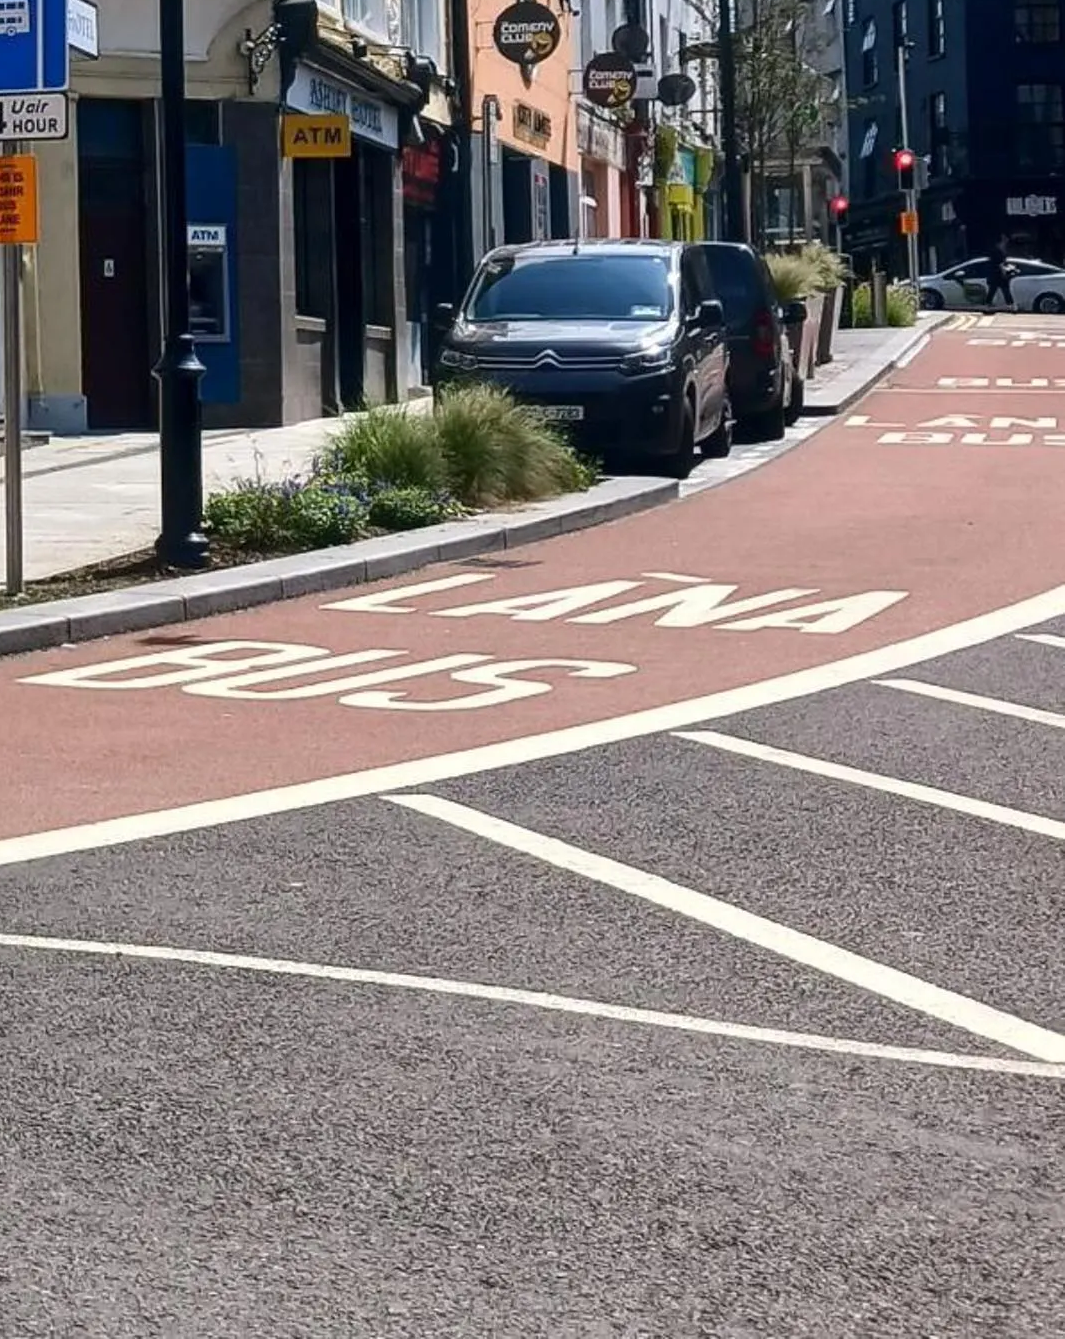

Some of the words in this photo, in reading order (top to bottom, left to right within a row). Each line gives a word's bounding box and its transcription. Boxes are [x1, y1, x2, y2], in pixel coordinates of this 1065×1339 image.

[10, 99, 49, 114] Uair
[12, 117, 59, 134] HOUR
[292, 125, 343, 146] ATM
[191, 229, 219, 241] ATM
[16, 639, 639, 712] BUS
